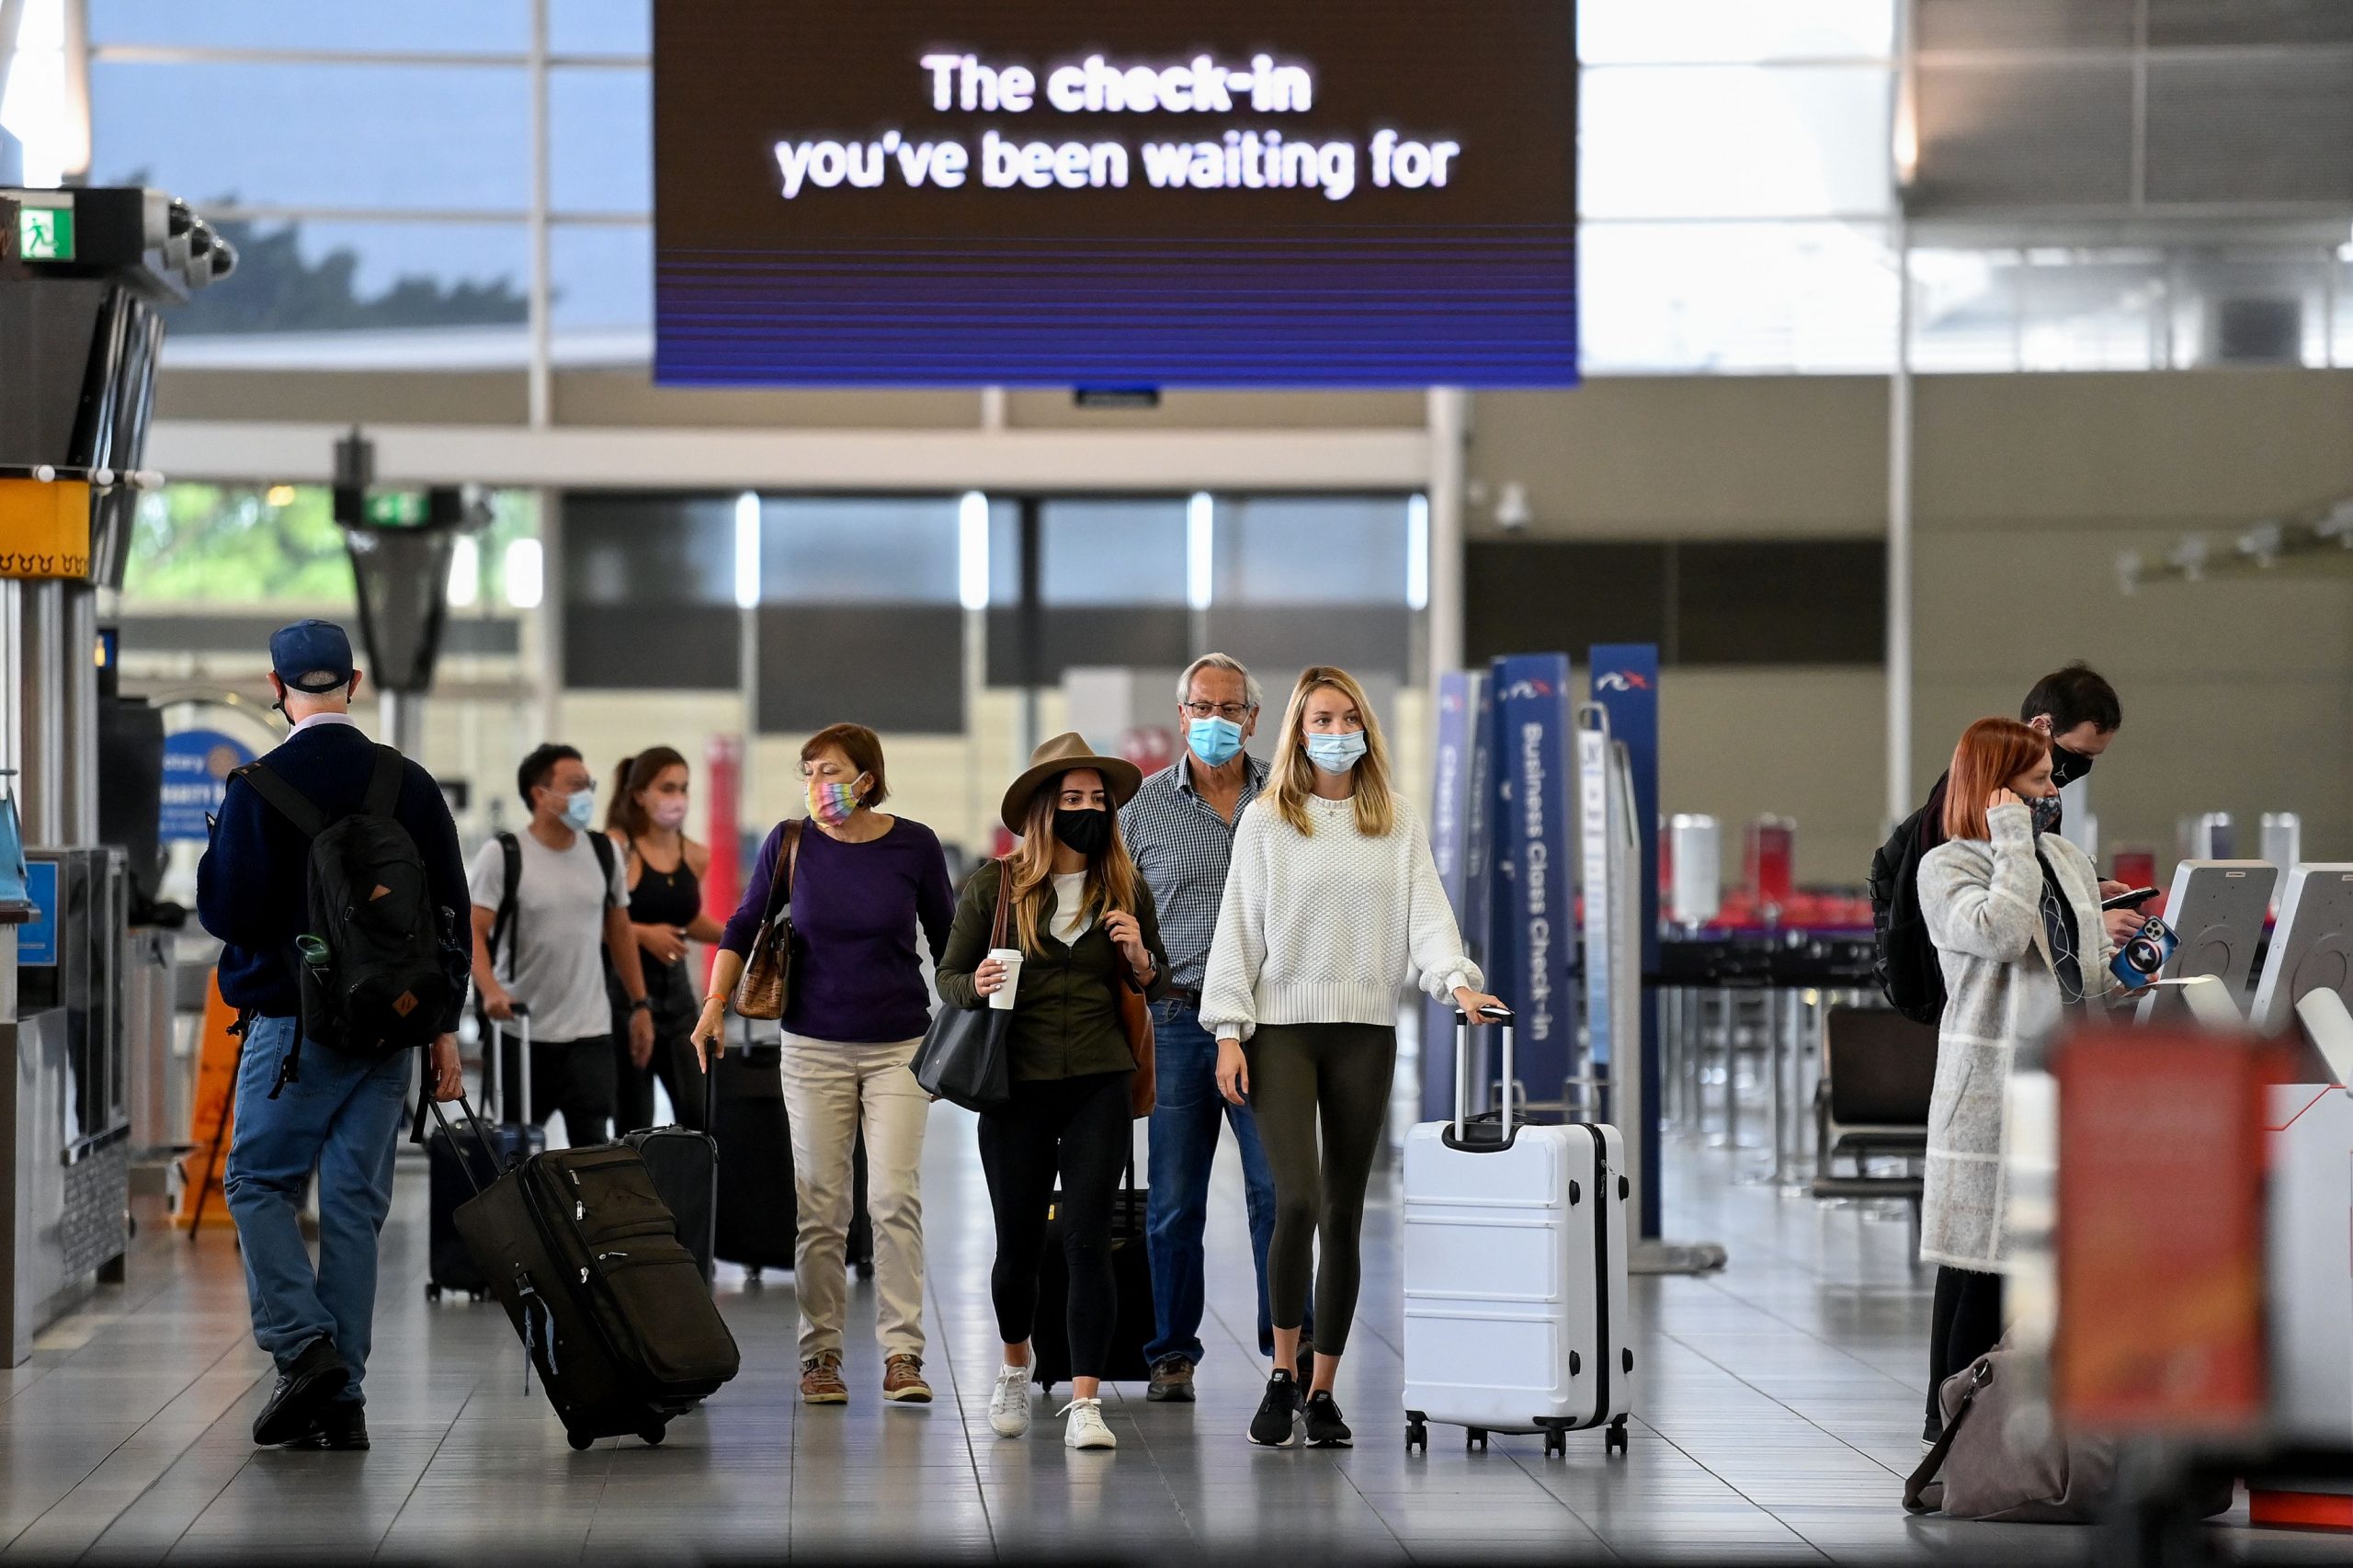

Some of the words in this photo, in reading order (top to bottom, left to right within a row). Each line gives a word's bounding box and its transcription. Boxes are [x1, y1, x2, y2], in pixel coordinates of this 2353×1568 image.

[920, 54, 1035, 112] The
[1047, 53, 1313, 113] check-in
[775, 131, 968, 199] you've
[982, 131, 1129, 188] been
[1142, 130, 1355, 200] waiting
[1370, 129, 1460, 188] for
[1521, 722, 1546, 838] Business
[1527, 841, 1548, 915] Class
[1529, 917, 1552, 1040] Check-in
